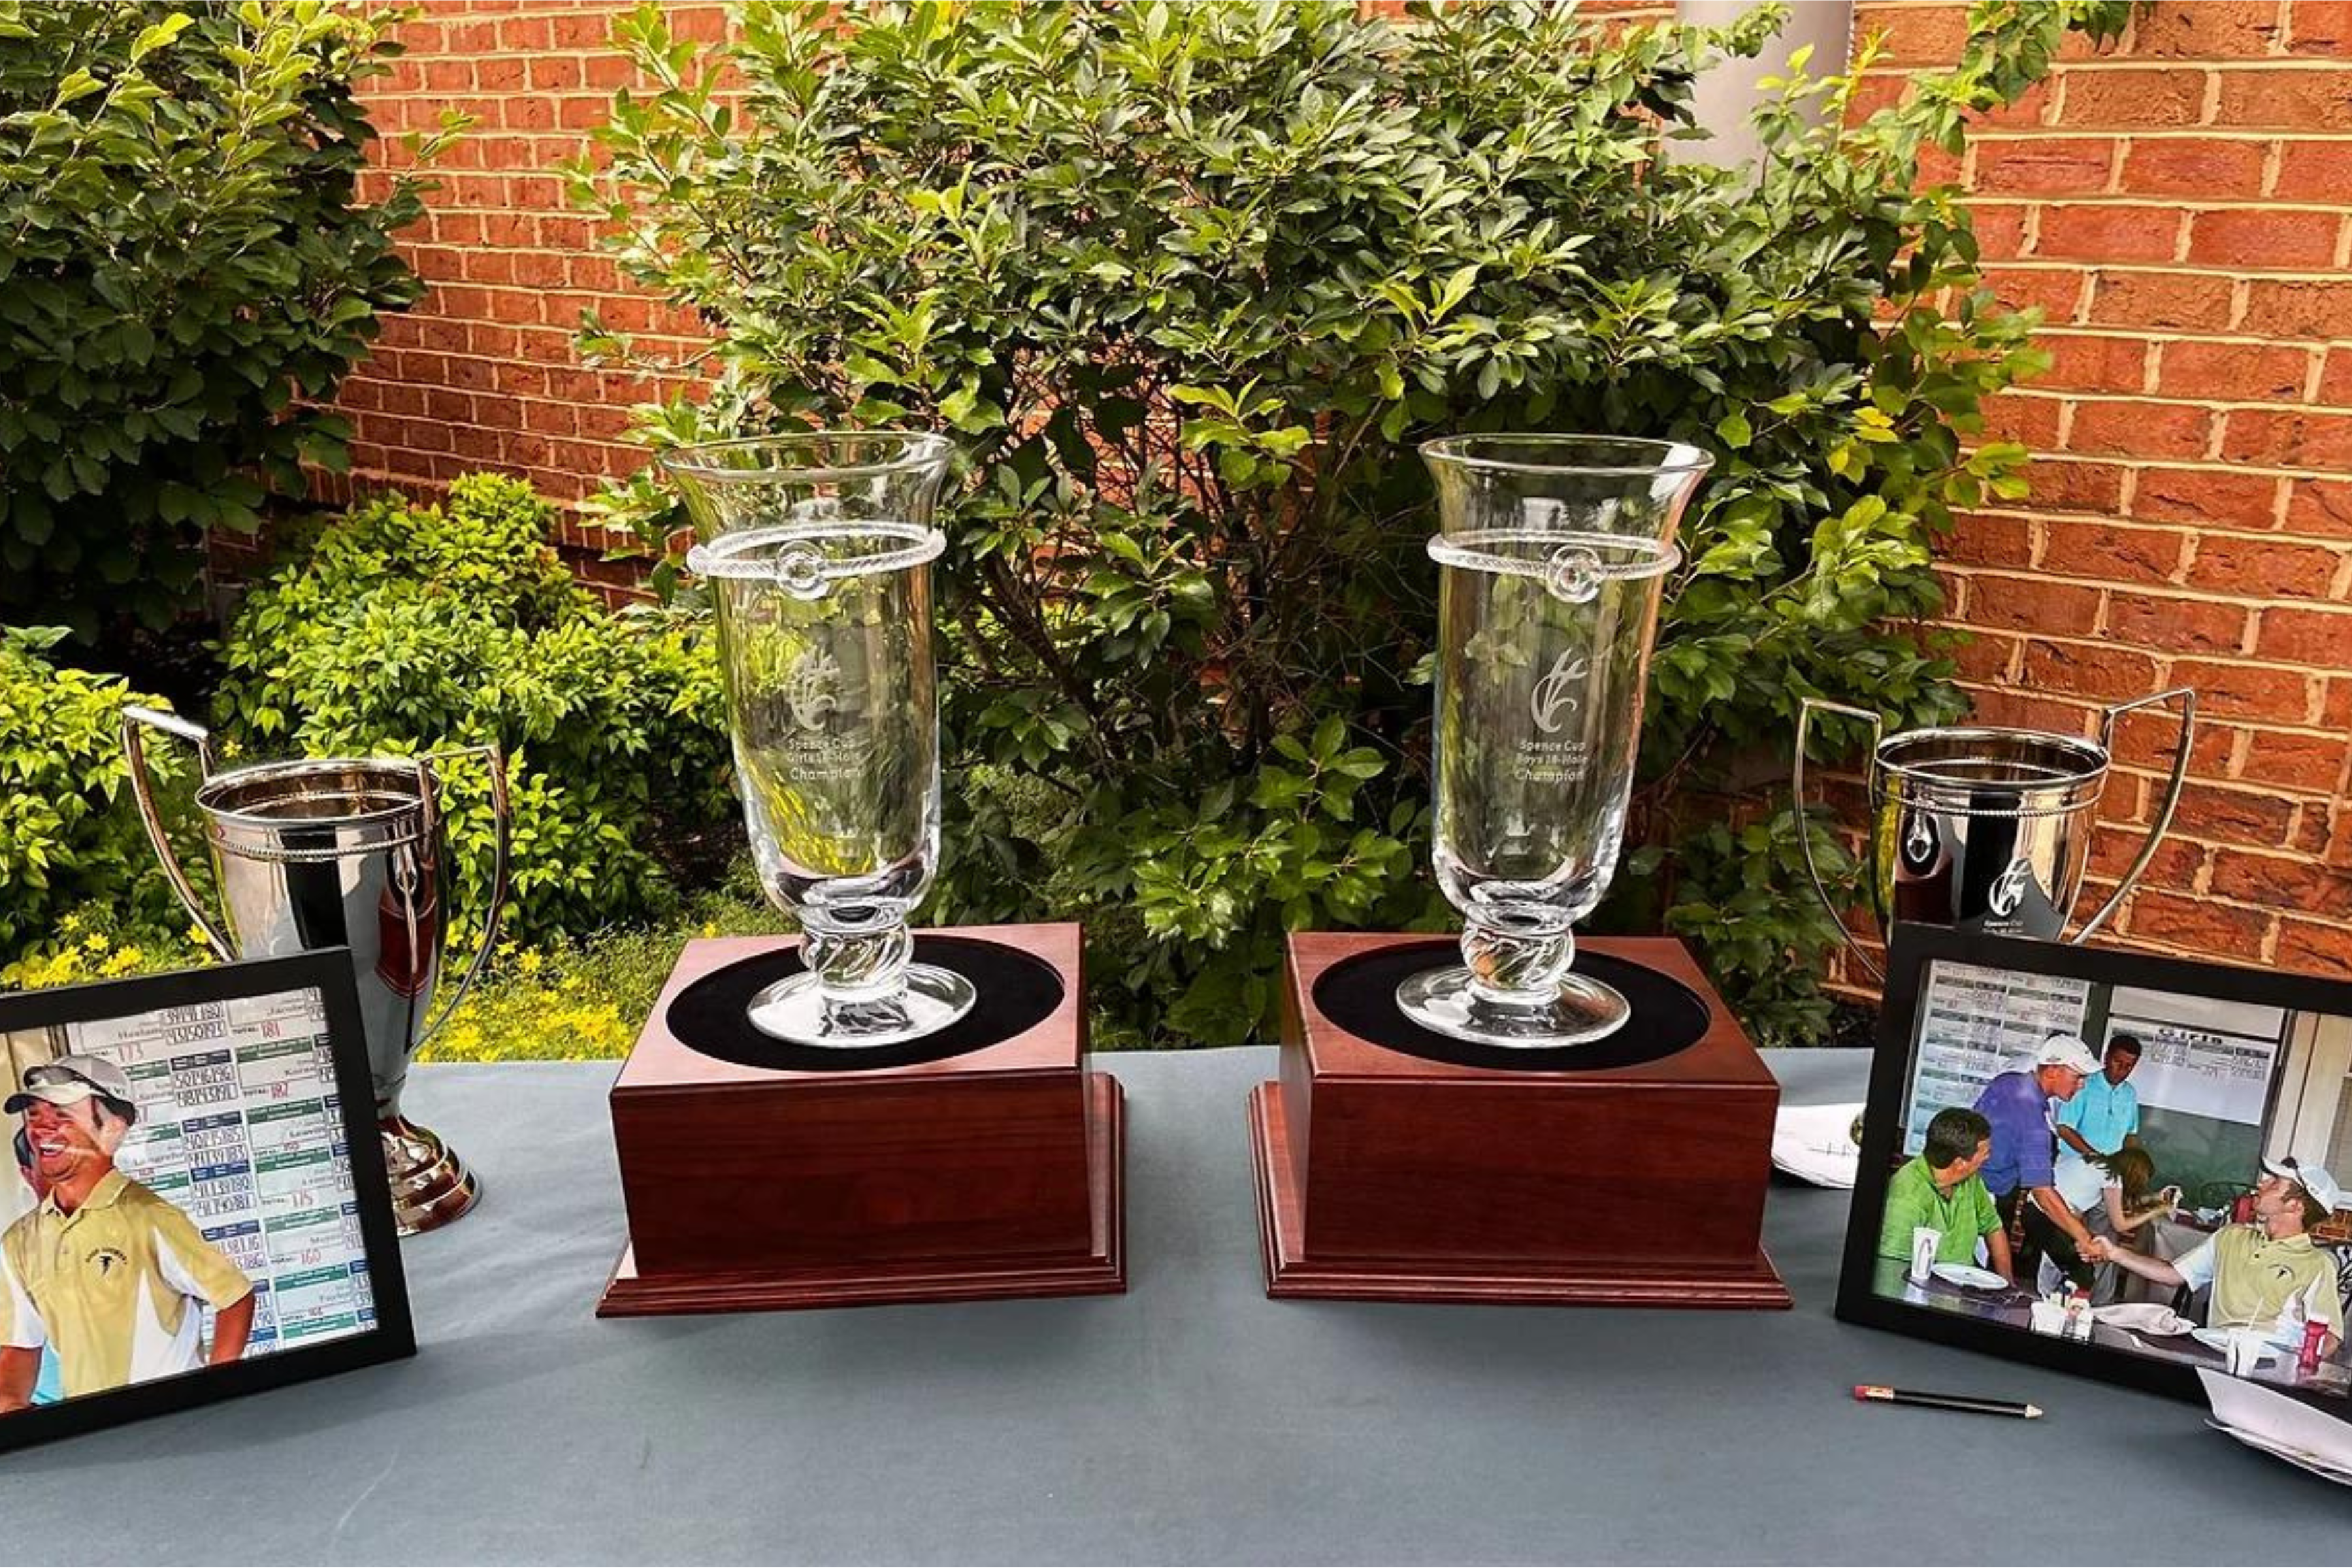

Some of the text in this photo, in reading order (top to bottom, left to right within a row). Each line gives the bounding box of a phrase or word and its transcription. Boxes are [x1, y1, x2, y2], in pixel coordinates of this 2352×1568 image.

[1519, 740, 1586, 752] Spence Cup
[1516, 753, 1543, 766] Boys
[789, 766, 861, 781] Champion
[1514, 766, 1585, 783] Champion
[2159, 1028, 2223, 1045] Girls
